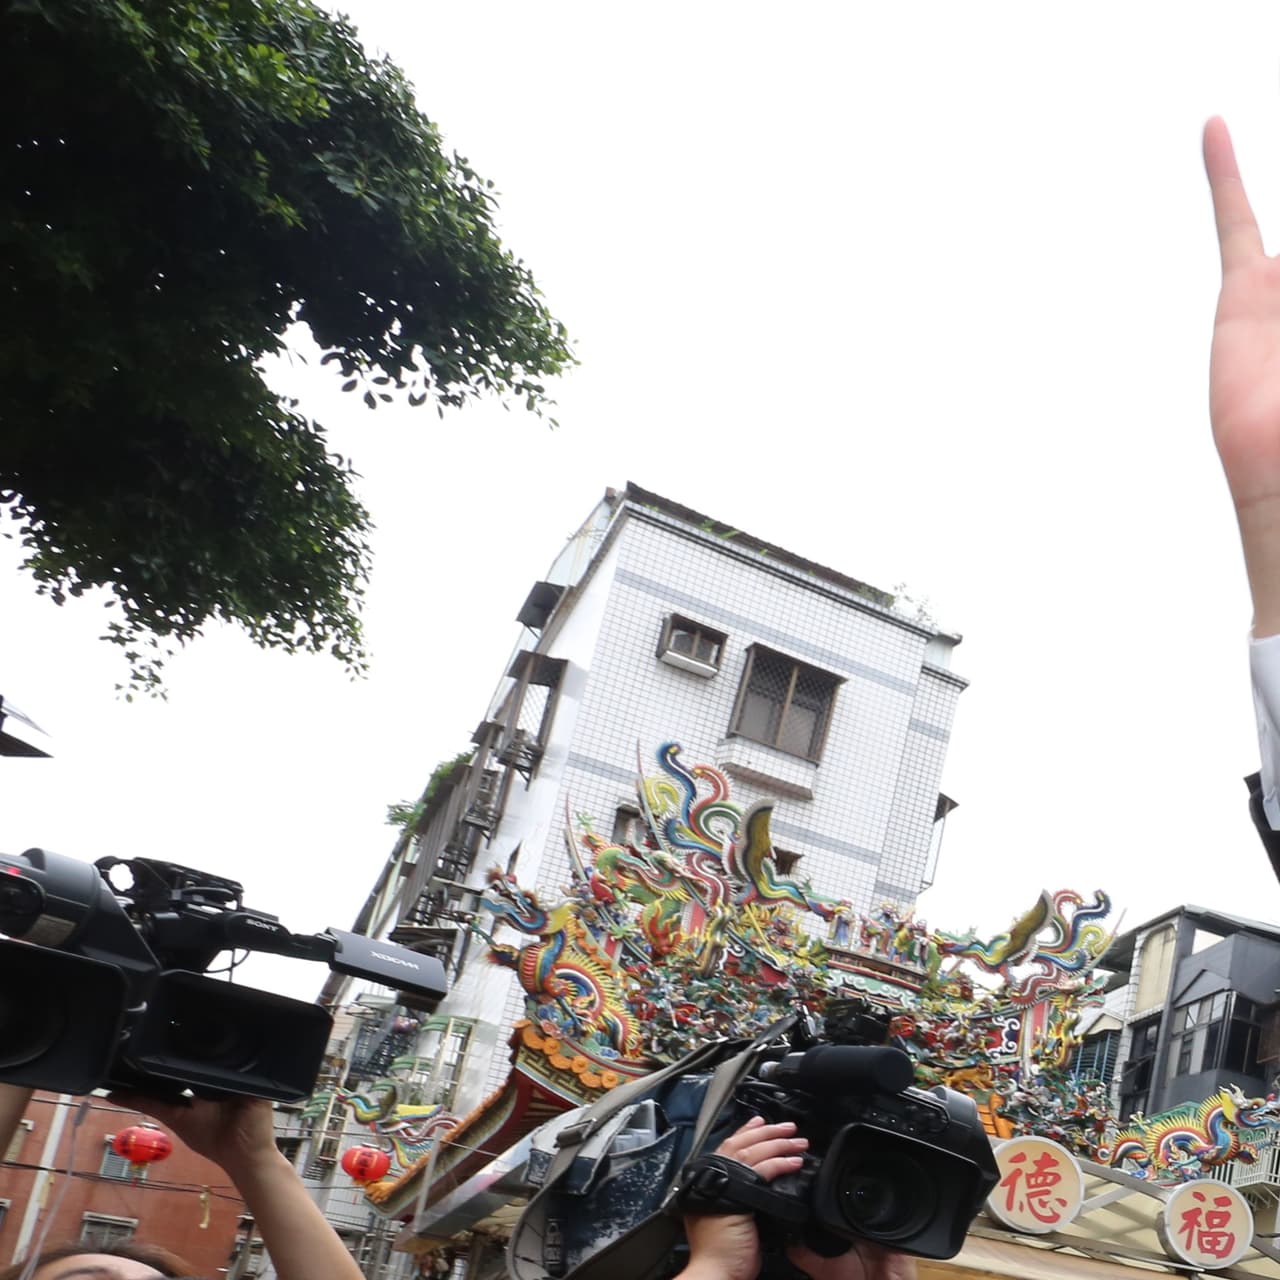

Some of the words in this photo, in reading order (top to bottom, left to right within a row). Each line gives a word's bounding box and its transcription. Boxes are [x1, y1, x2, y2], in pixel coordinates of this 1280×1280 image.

[245, 918, 280, 932] SONY
[999, 1151, 1068, 1224] 德
[1177, 1191, 1236, 1259] 福
